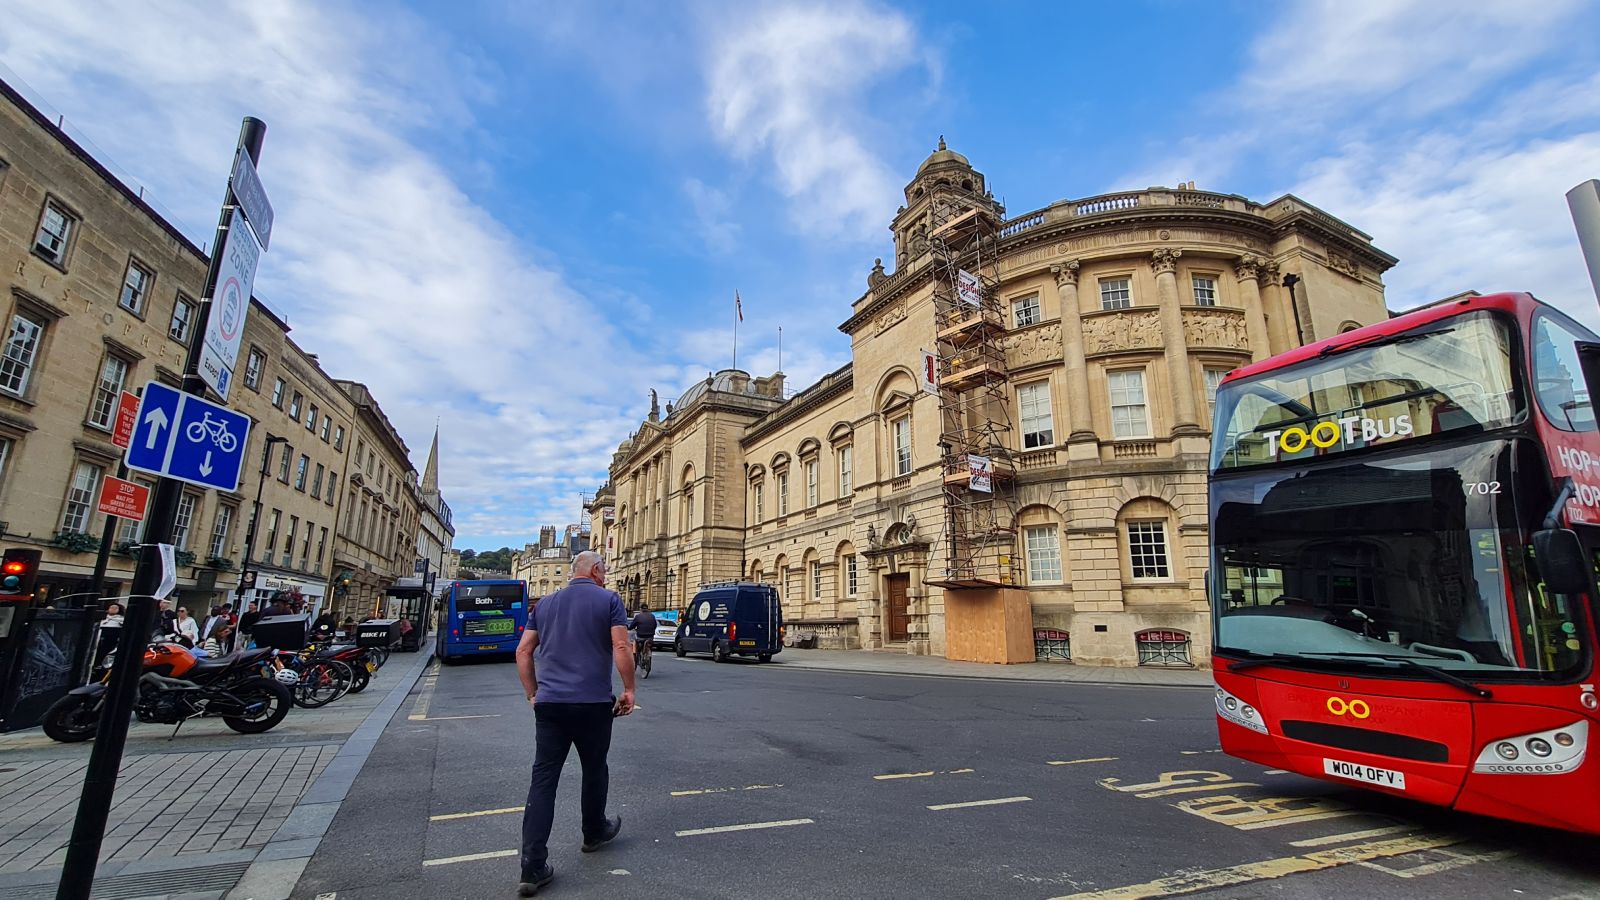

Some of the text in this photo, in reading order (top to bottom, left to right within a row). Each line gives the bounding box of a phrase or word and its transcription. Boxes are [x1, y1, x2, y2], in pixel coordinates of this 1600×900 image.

[230, 246, 249, 285] ZONE
[958, 280, 980, 297] DESIGN
[204, 357, 220, 380] Except
[1557, 445, 1600, 472] HOP-
[120, 483, 135, 494] STOP
[1465, 481, 1502, 496] 702
[1568, 507, 1584, 521] 702
[466, 587, 473, 596] 7
[475, 596, 493, 605] Bath
[1332, 761, 1395, 784] WO14 OFV
